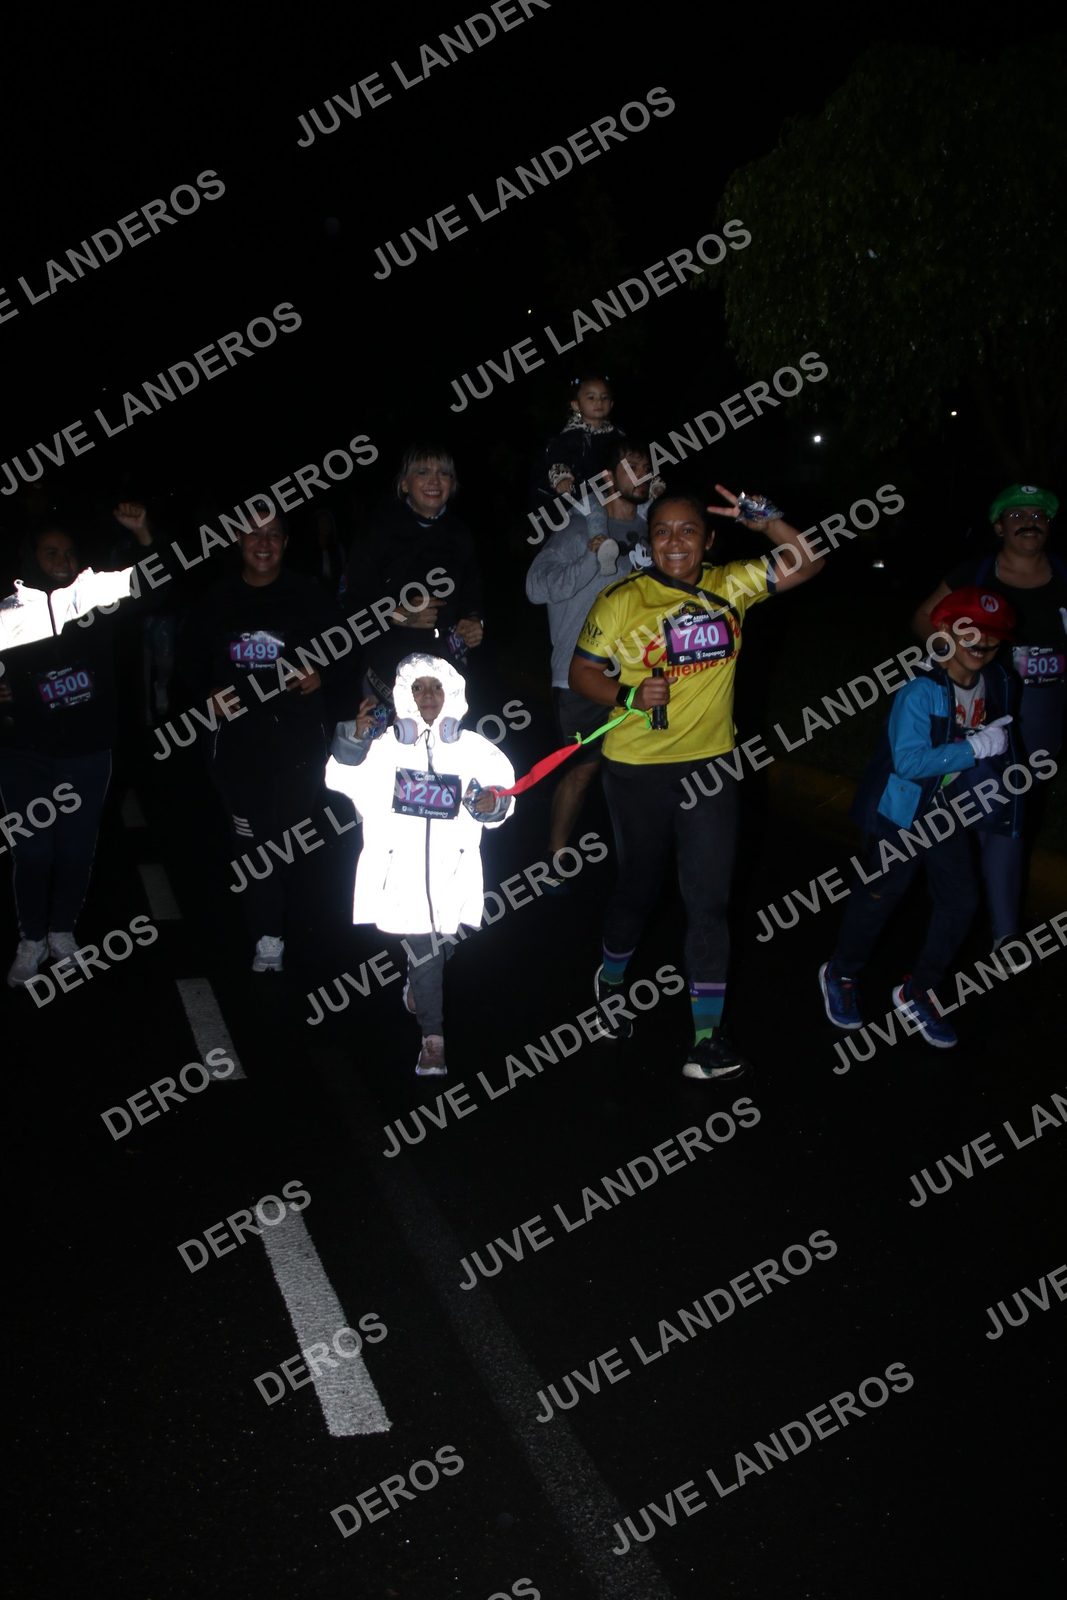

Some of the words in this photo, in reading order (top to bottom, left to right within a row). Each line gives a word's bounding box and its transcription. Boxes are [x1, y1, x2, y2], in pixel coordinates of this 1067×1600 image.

[680, 624, 719, 650] 740
[232, 643, 278, 660] 1499
[1027, 656, 1059, 675] 503
[43, 671, 89, 700] 1500
[402, 782, 454, 807] 1276
